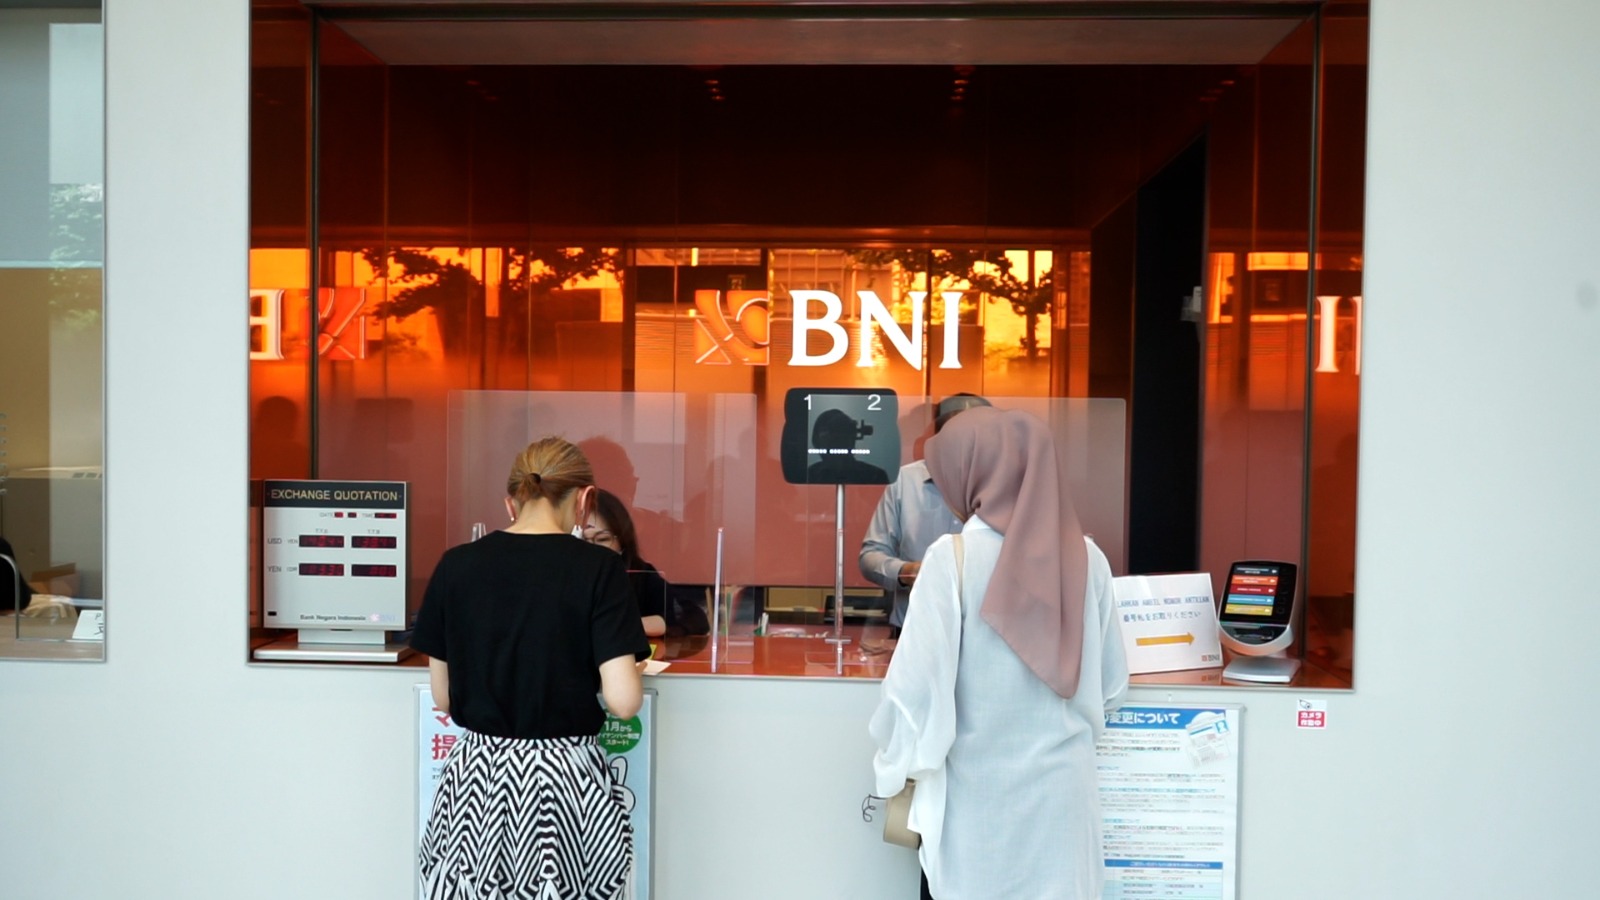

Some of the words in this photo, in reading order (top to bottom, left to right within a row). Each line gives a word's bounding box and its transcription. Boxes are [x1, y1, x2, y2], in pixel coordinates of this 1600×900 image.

[787, 290, 963, 371] BNI
[803, 394, 811, 410] 1
[867, 394, 882, 411] 2
[271, 489, 331, 500] EXCHANGE
[333, 490, 398, 501] QUOTATION
[1123, 611, 1201, 622] 番号札をお取りください
[604, 721, 632, 732] 1月から
